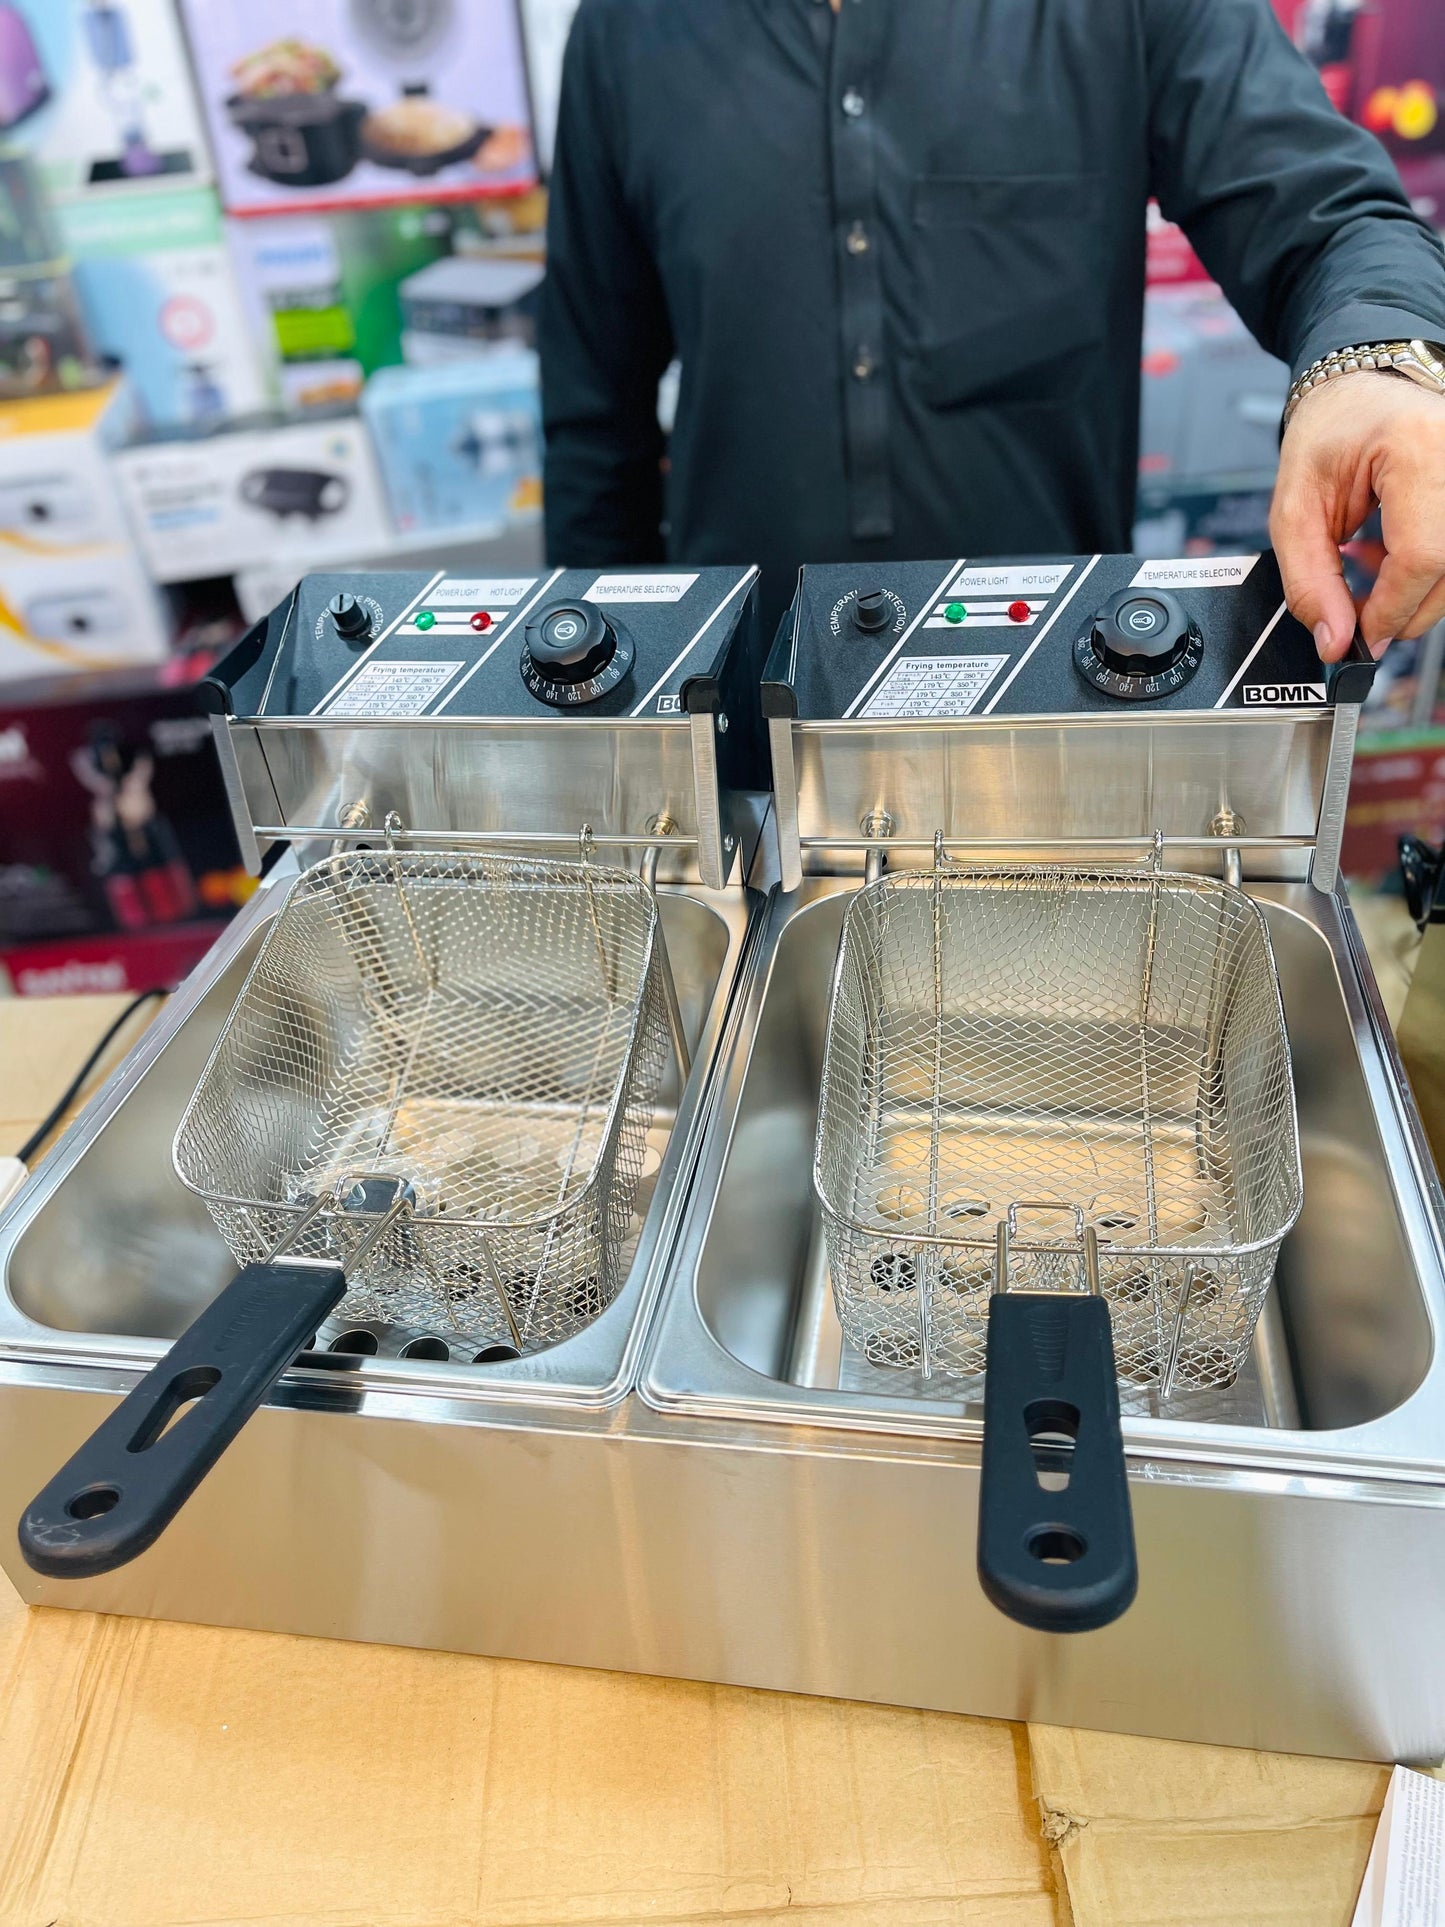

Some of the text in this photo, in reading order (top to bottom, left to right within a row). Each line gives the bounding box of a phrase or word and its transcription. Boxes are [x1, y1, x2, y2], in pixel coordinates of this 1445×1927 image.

[1022, 575, 1060, 584] HOT LIGHT
[1144, 568, 1242, 580] TEMPERATURE SELECTION
[960, 577, 1008, 586] POWER LIGHT
[596, 585, 681, 594] TEMPERATURE SELECTION
[1095, 672, 1110, 685] 160
[1169, 671, 1183, 685] 100
[529, 679, 540, 692] 160
[590, 681, 605, 695] 100
[1119, 682, 1134, 693] 140
[1145, 682, 1160, 693] 120
[545, 689, 559, 700] 140
[567, 691, 581, 701] 120
